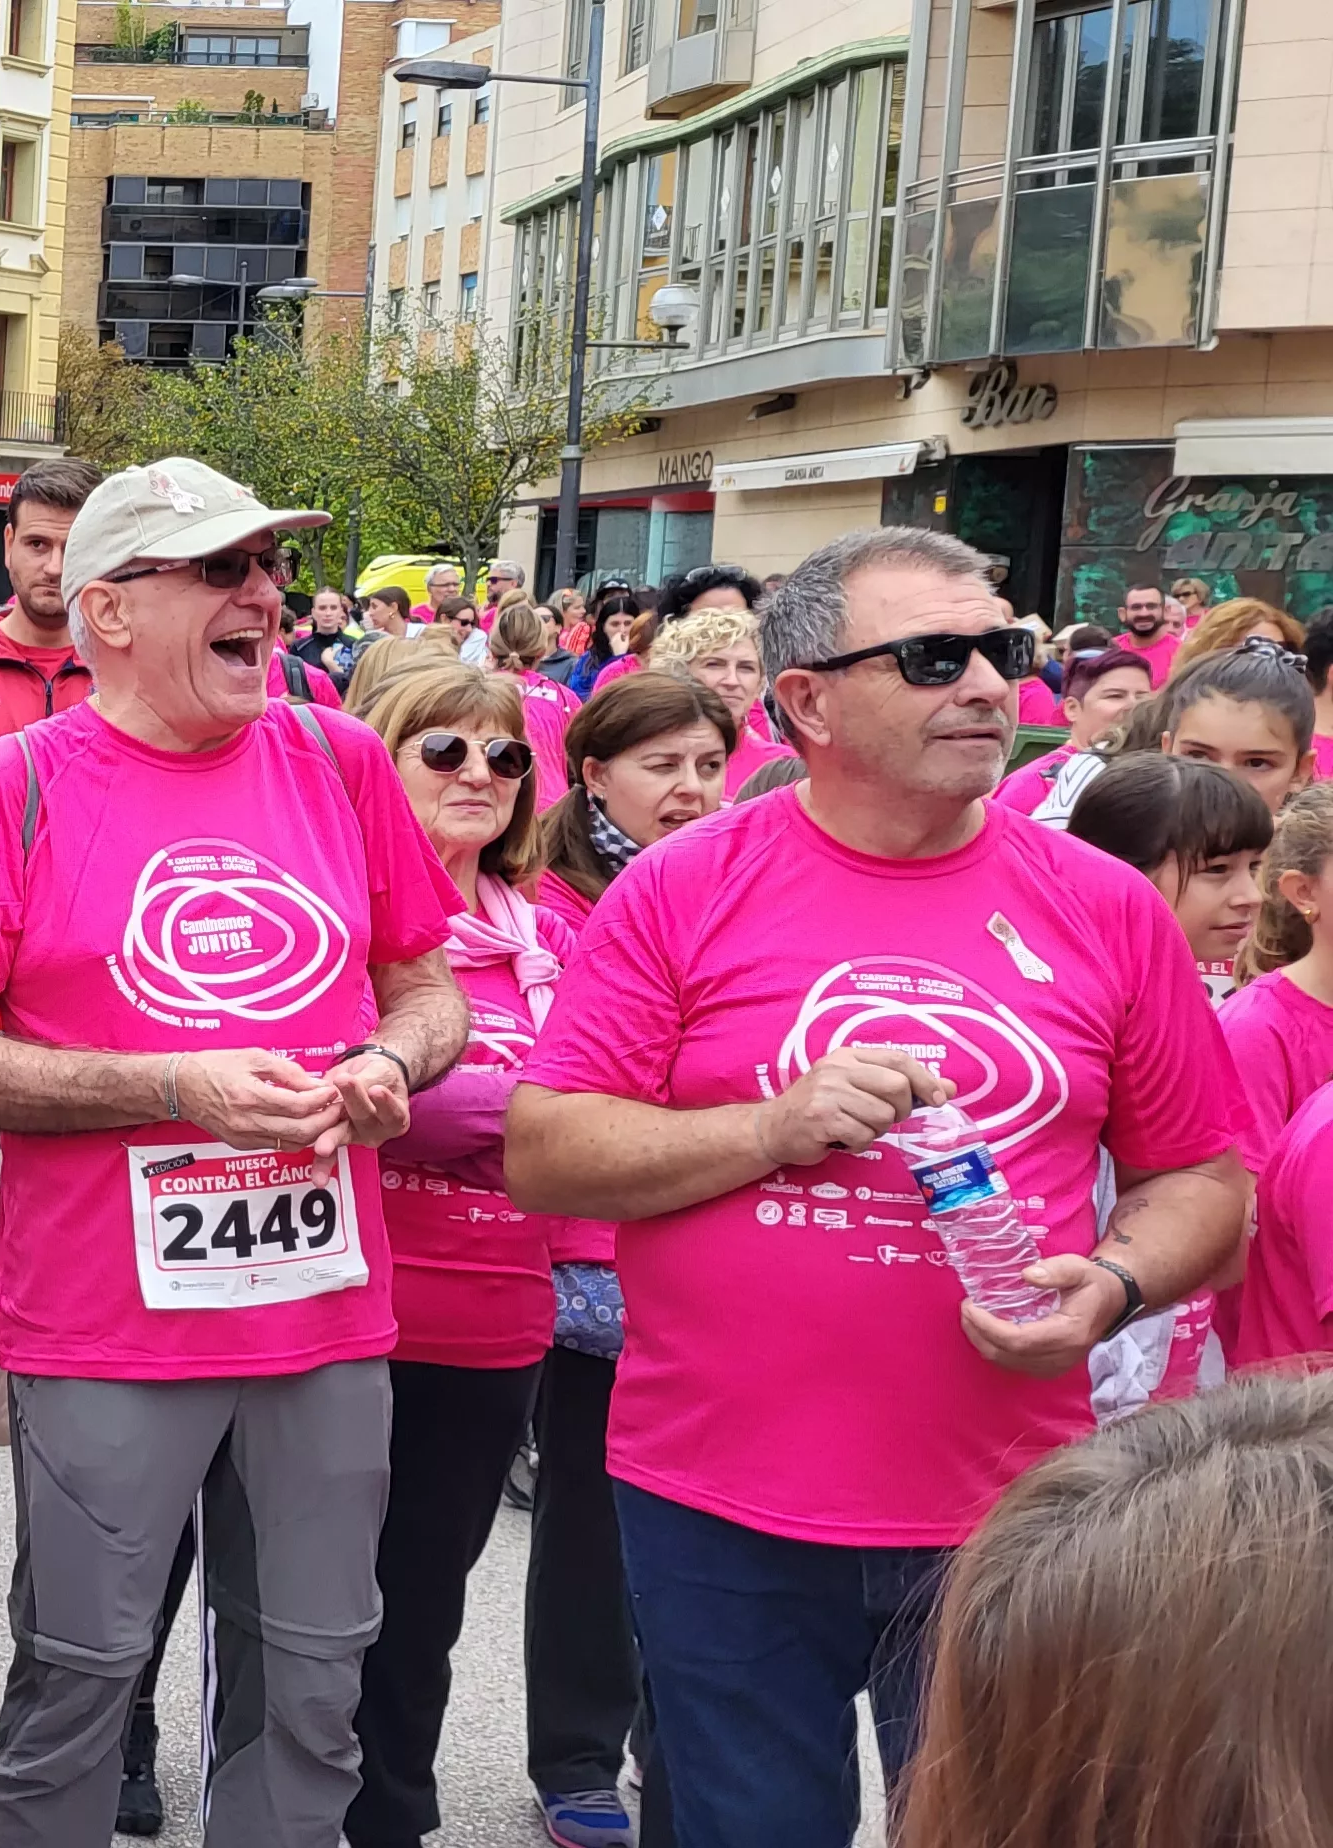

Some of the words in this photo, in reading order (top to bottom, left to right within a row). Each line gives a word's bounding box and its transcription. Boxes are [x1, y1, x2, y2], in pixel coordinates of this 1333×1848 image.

[961, 362, 1058, 430] Bar
[658, 451, 714, 484] MANGO
[1136, 475, 1301, 552] Granja
[180, 915, 253, 935] Caminemos
[188, 931, 252, 954] JUNTOS
[1211, 962, 1228, 974] EL
[160, 1173, 241, 1193] CONTRA
[245, 1172, 264, 1188] EL
[269, 1163, 313, 1184] CÁNC
[225, 1156, 278, 1172] HUESCA
[160, 1188, 336, 1261] 2449
